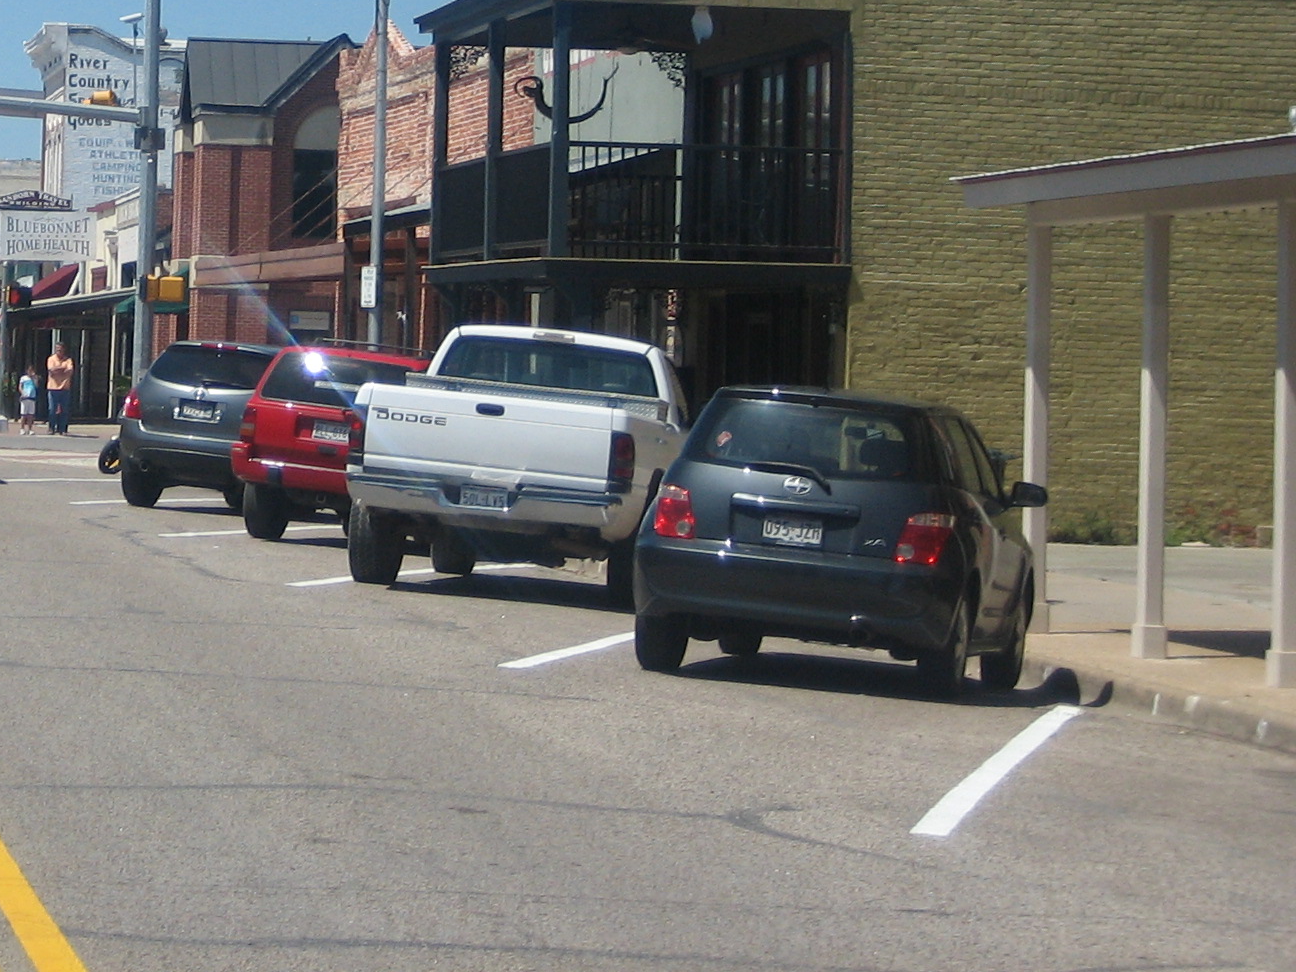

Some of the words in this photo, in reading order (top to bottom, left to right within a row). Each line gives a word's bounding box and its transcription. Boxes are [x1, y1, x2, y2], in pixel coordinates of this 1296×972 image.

[69, 53, 110, 70] River
[68, 73, 130, 91] Country
[90, 150, 141, 160] ATHLETI
[38, 191, 69, 207] TRAVEL
[7, 216, 90, 234] BLUEBONNET
[7, 239, 41, 256] HOME
[44, 238, 90, 257] HEALTH
[372, 407, 447, 426] DODGE
